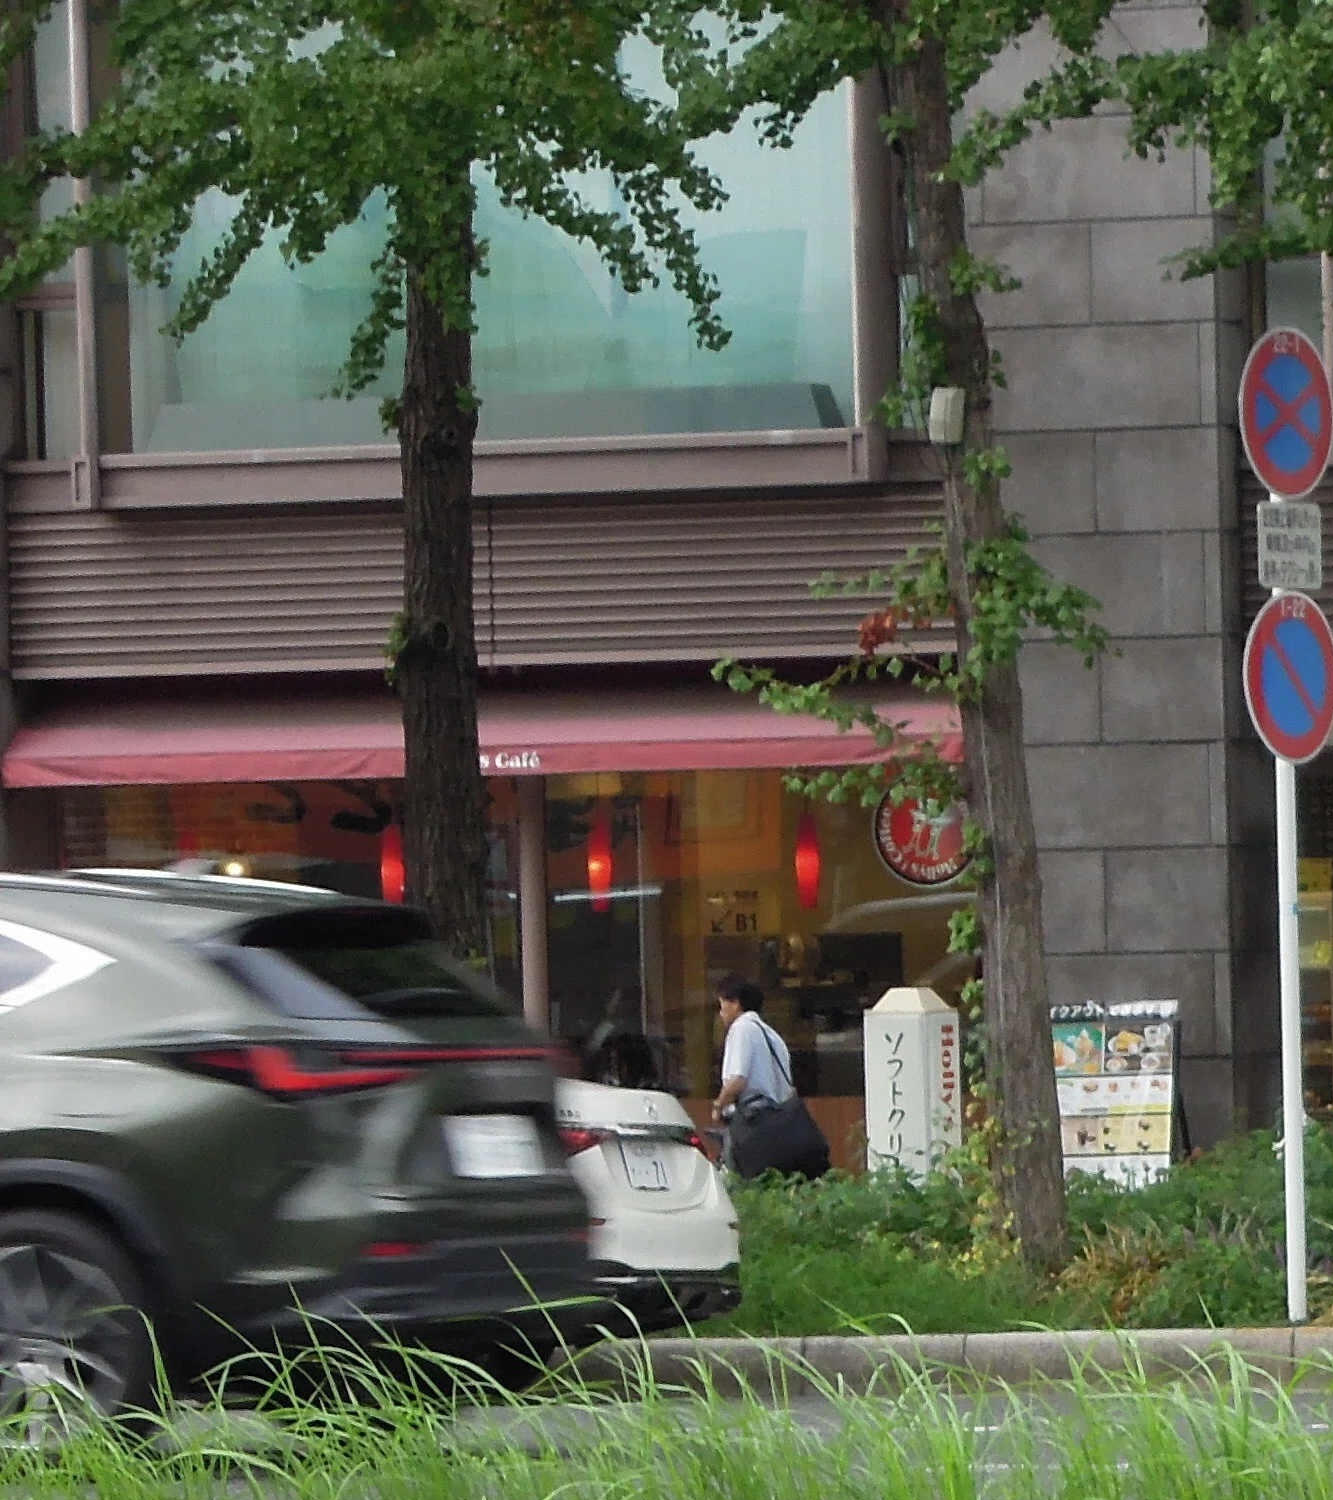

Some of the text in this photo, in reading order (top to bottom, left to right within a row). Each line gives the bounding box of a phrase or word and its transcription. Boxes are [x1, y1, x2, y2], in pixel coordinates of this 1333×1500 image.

[494, 750, 540, 769] Café
[884, 1031, 906, 1153] ソフトクリ
